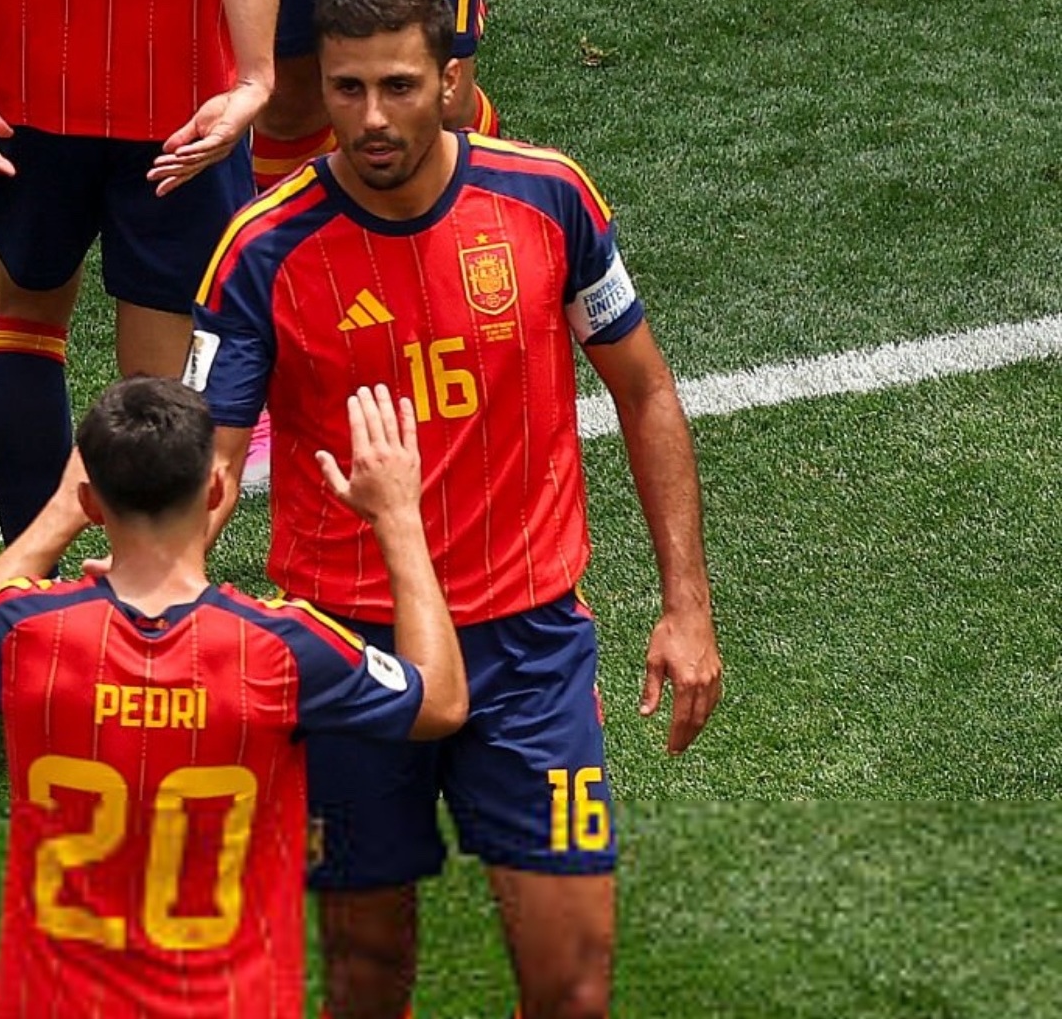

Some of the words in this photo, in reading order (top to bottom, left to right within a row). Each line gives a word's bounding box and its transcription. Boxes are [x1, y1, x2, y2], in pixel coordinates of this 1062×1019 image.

[403, 336, 478, 423] 16
[94, 683, 207, 729] PEDRI
[28, 754, 258, 950] 20
[548, 767, 610, 852] 16
